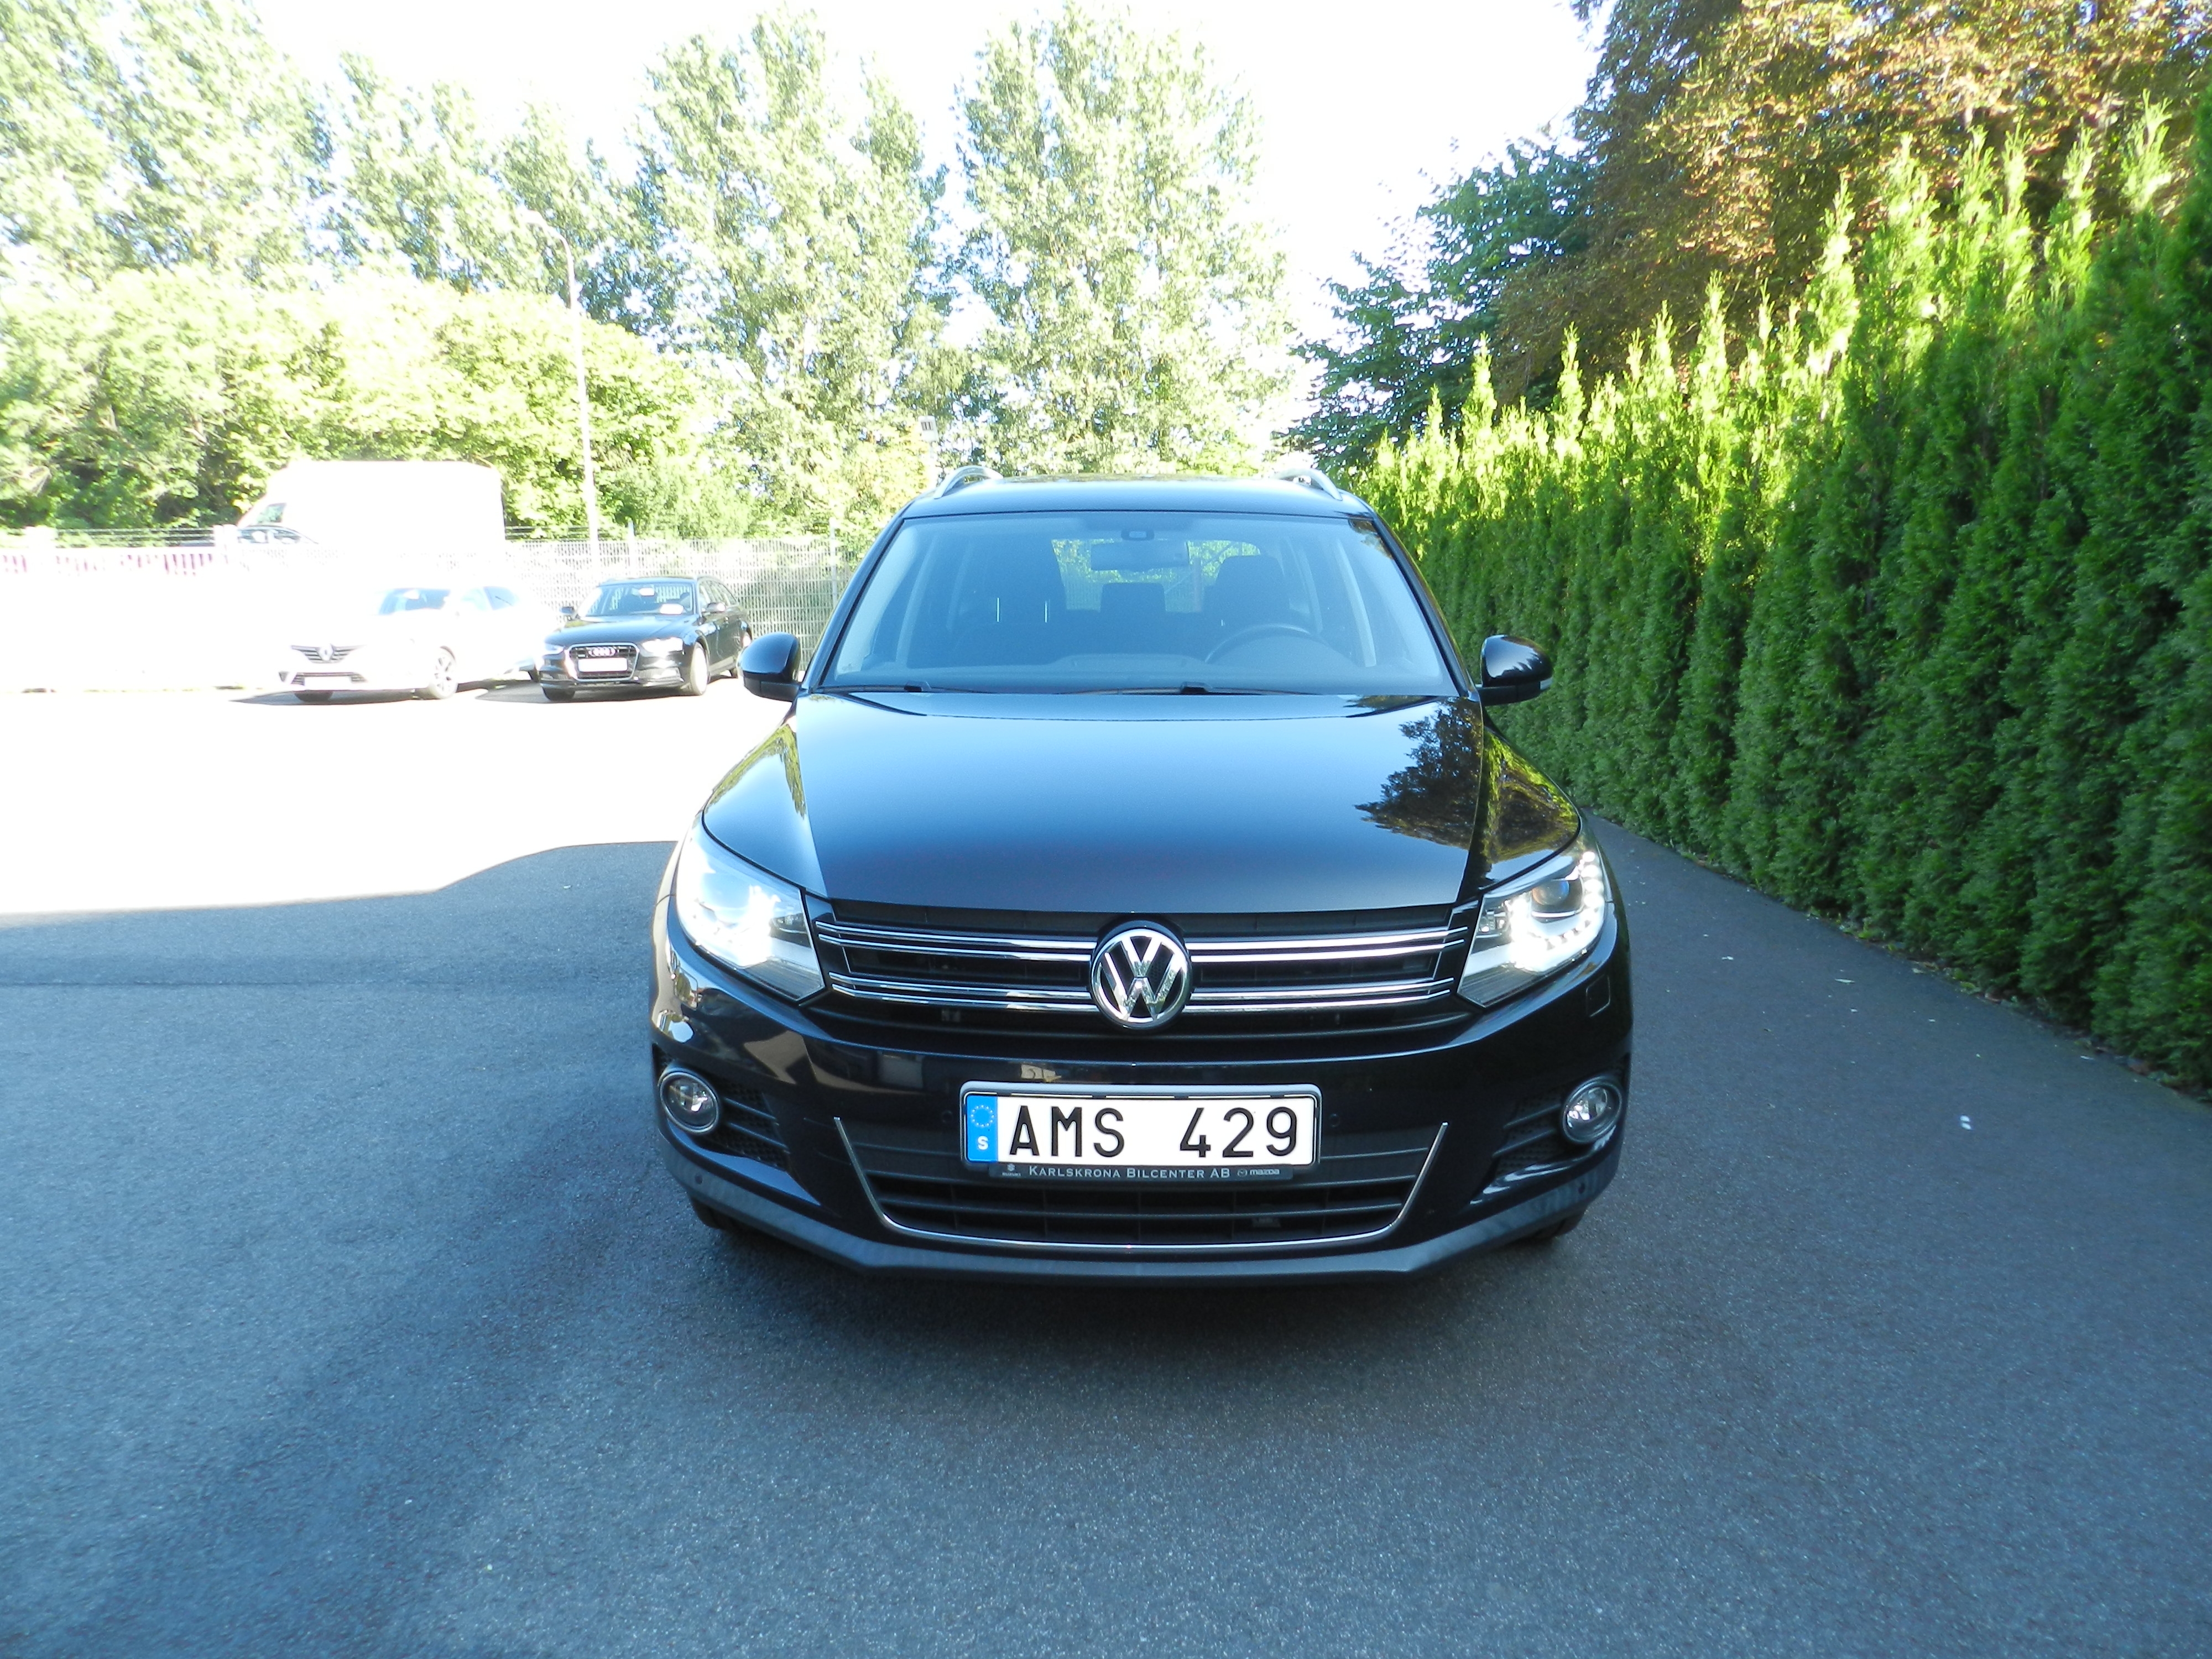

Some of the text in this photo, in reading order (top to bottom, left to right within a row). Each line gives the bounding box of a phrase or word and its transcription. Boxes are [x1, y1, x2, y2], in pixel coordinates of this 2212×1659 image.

[1010, 1105, 1297, 1157] AMS 429
[977, 1135, 989, 1150] S
[1029, 1165, 1230, 1178] KARLSKRONA BILCENTER AB
